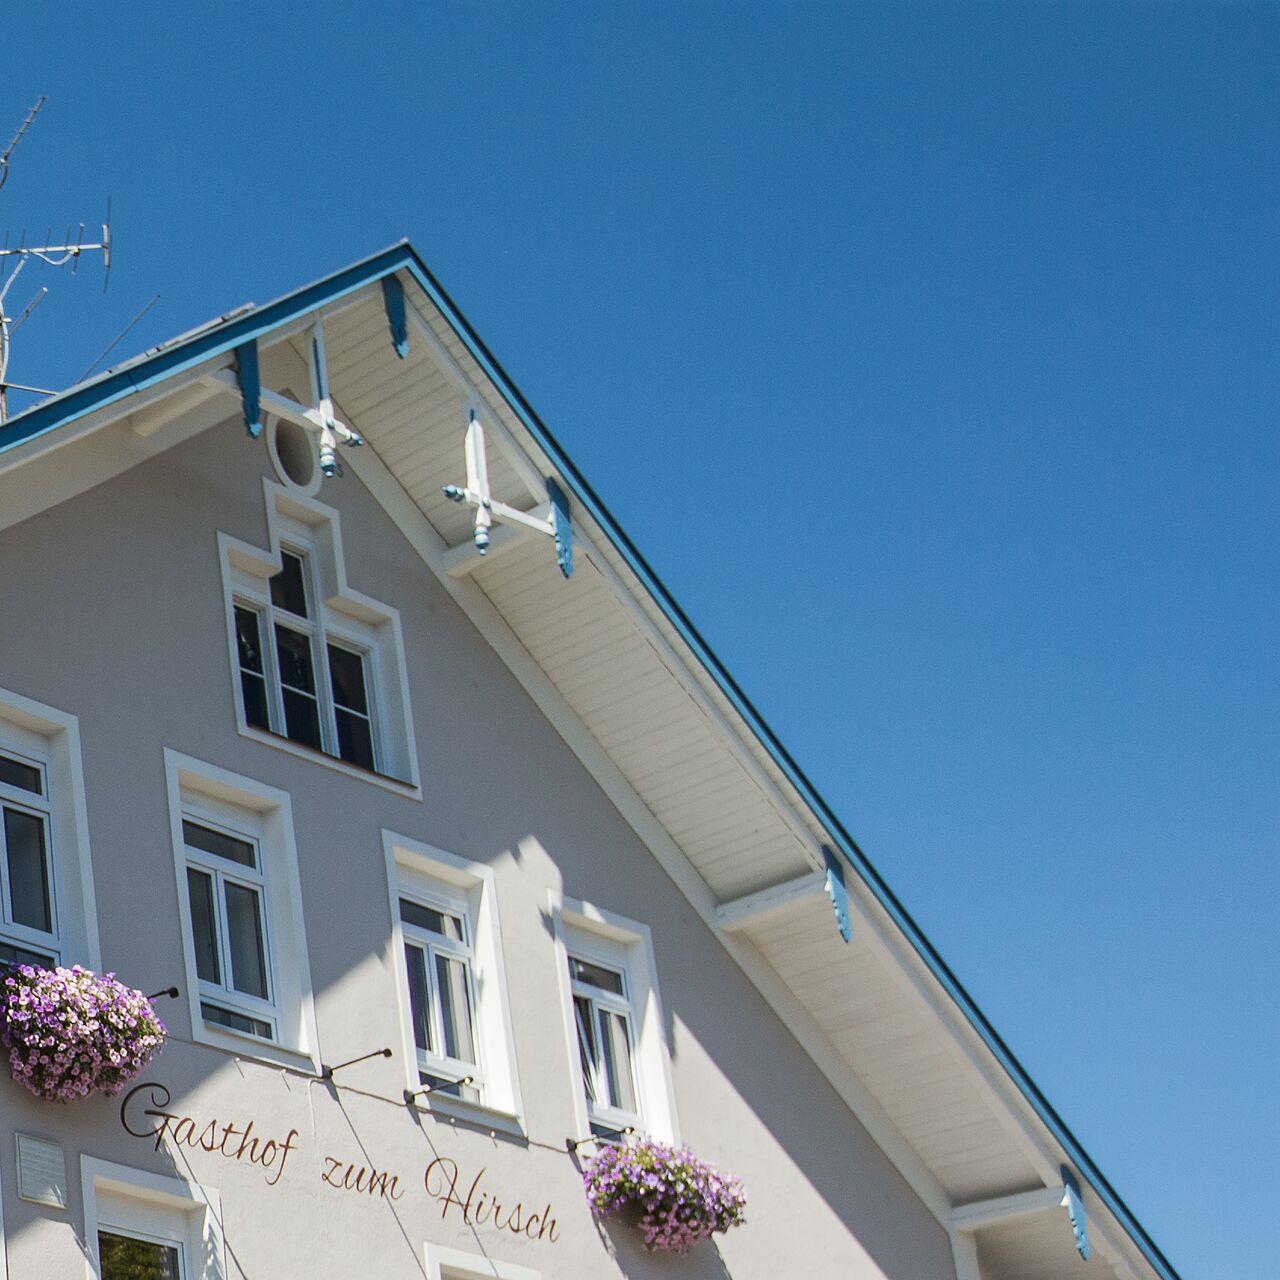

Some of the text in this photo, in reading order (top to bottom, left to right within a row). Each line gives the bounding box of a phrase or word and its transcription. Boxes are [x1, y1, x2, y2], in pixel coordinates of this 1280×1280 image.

[120, 1082, 562, 1243] Gasthof zum Hirsch
